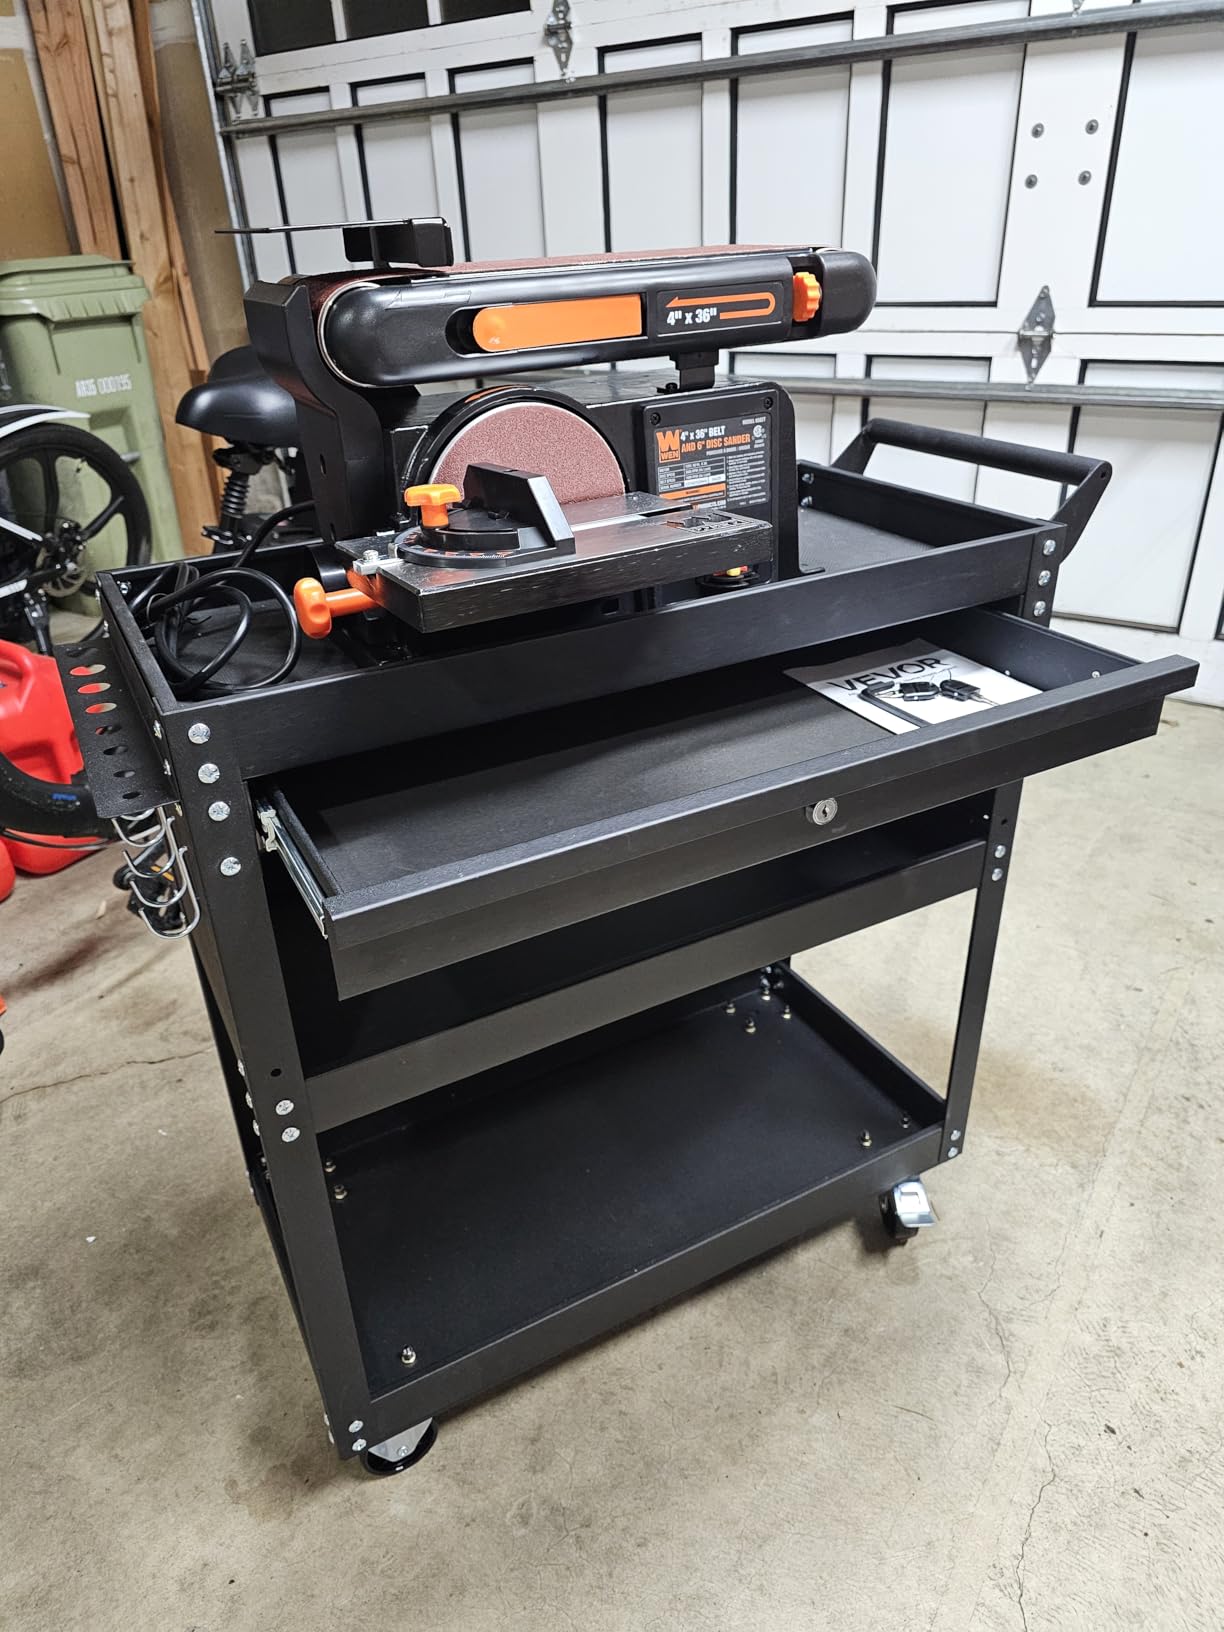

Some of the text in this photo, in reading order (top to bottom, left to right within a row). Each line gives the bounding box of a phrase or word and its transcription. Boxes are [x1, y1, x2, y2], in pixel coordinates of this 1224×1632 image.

[667, 307, 717, 325] 4" x 36"
[689, 432, 695, 440] x
[695, 428, 708, 440] 36"
[709, 426, 726, 437] BELT
[681, 441, 696, 453] AND
[706, 437, 723, 449] DISC
[724, 434, 750, 446] SANDER
[660, 450, 679, 460] WEN
[827, 657, 950, 691] VEVOR
